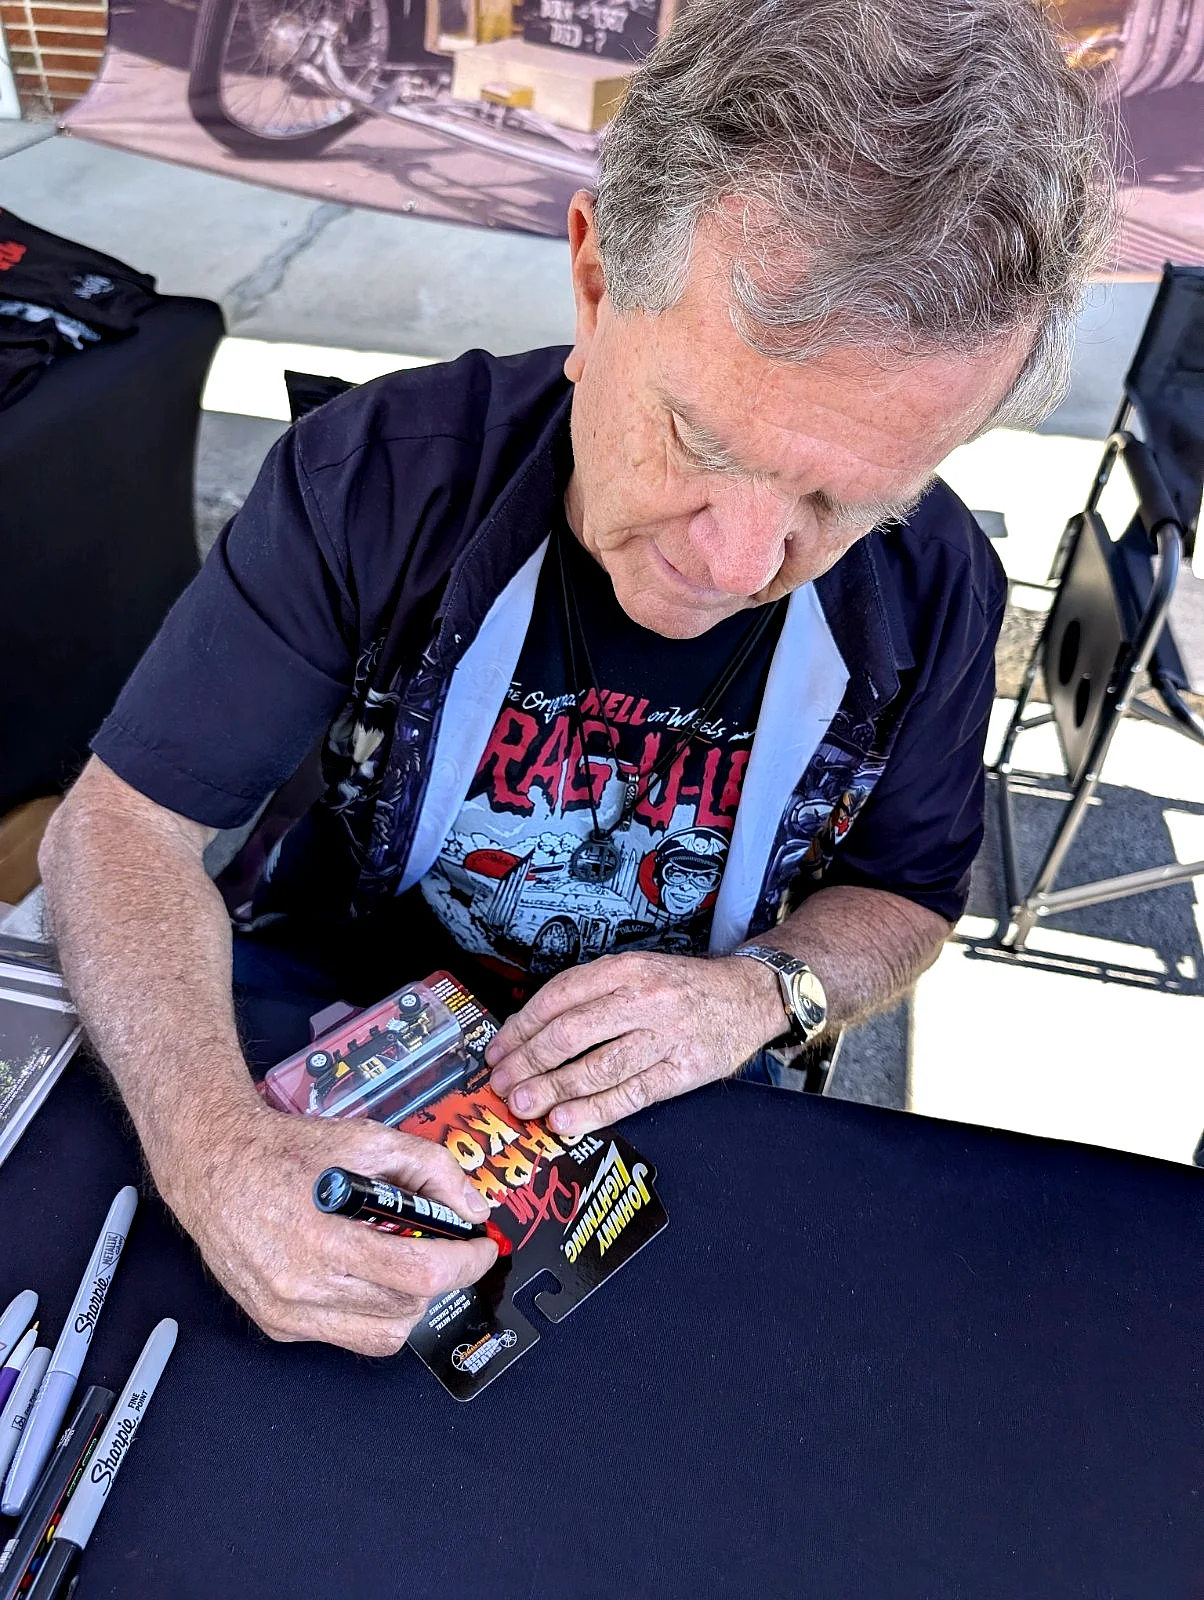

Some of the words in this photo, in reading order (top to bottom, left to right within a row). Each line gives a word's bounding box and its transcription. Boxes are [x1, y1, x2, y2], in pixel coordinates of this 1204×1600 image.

[580, 687, 650, 725] HELL
[647, 711, 670, 722] on
[568, 1136, 605, 1165] THE
[564, 1140, 632, 1264] LIGHTNING
[596, 1162, 651, 1257] JOHNNY
[102, 1235, 118, 1265] METALLIC
[468, 1345, 502, 1374] SILVER
[128, 1392, 140, 1409] FINE
[135, 1389, 148, 1412] POINT
